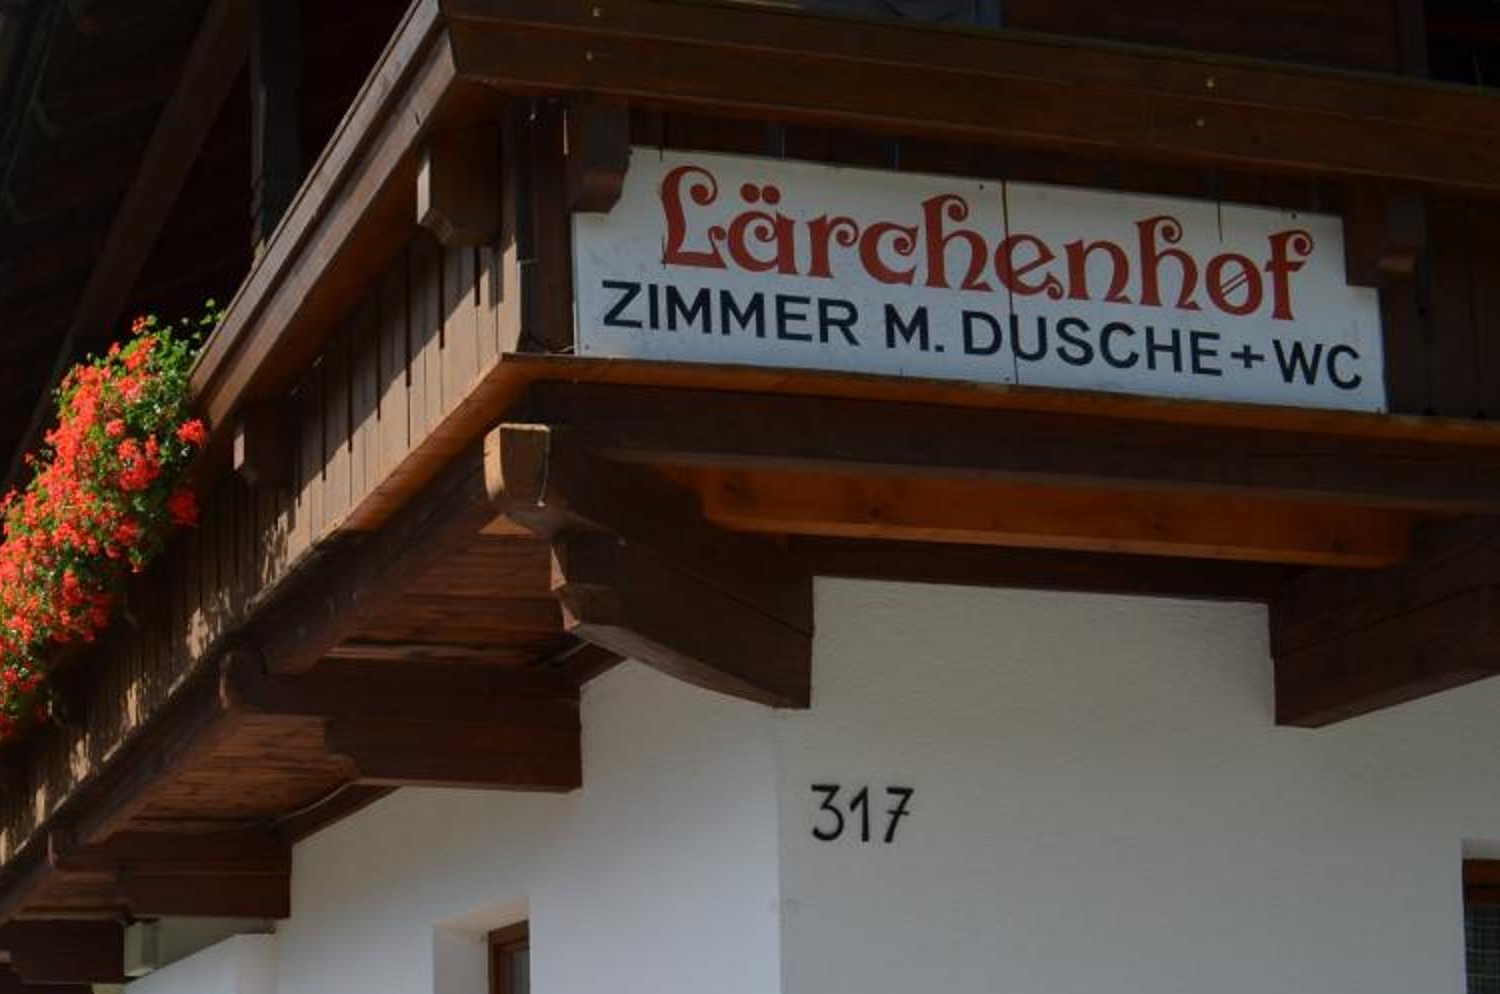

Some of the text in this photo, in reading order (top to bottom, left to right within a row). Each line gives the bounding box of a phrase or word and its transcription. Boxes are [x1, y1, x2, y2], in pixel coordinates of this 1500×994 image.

[660, 165, 1313, 321] Lärchenhof
[602, 280, 861, 346] ZIMMER
[884, 303, 945, 352] M.
[810, 784, 915, 843] 317
